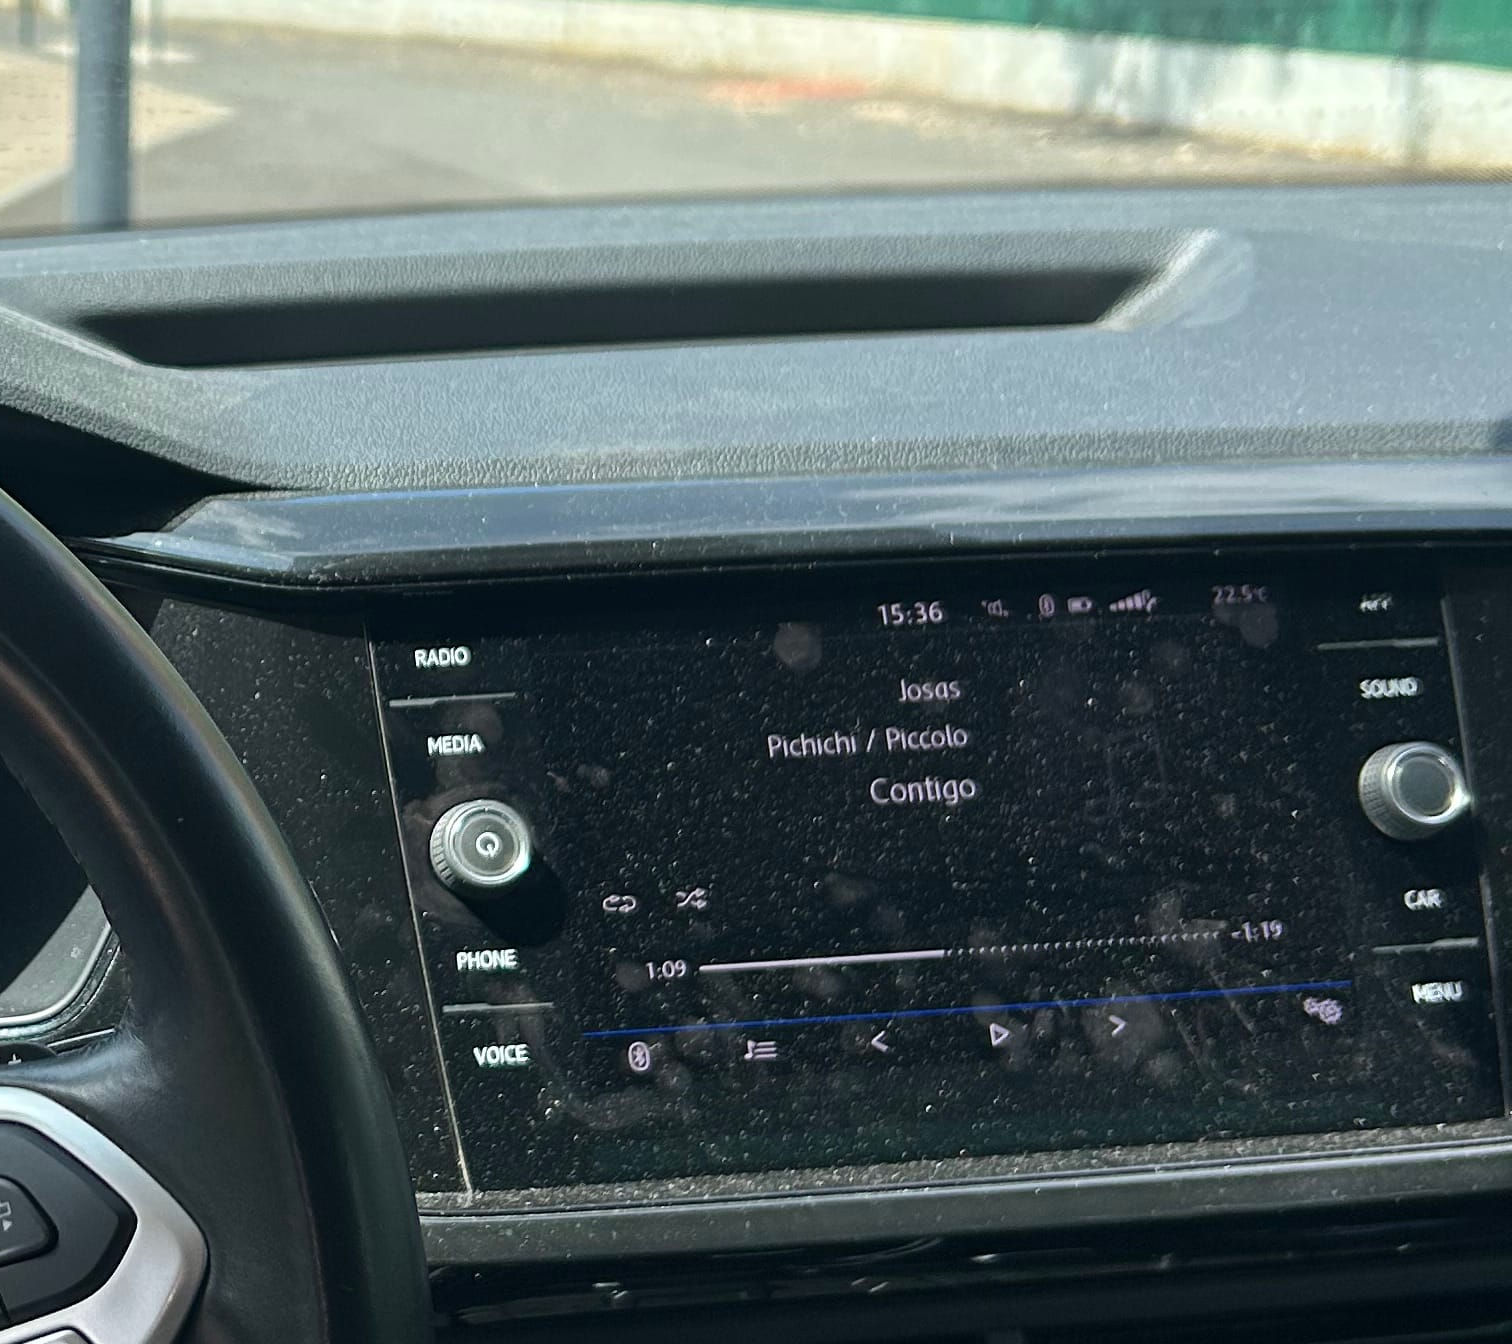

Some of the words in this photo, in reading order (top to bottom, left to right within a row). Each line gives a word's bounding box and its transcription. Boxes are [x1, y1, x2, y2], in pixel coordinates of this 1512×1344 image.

[877, 601, 944, 626] 15:36
[414, 646, 471, 669] RADIO
[899, 678, 961, 702] Josas
[1360, 676, 1420, 699] SOUND
[427, 733, 485, 756] MEDIA
[767, 731, 857, 759] Pichichi
[886, 724, 968, 752] Piccolo
[870, 776, 977, 806] Contigo
[1404, 888, 1445, 911] CAR
[456, 948, 519, 971] PHONE
[645, 960, 687, 980] 1:09
[474, 1043, 530, 1066] VOICE
